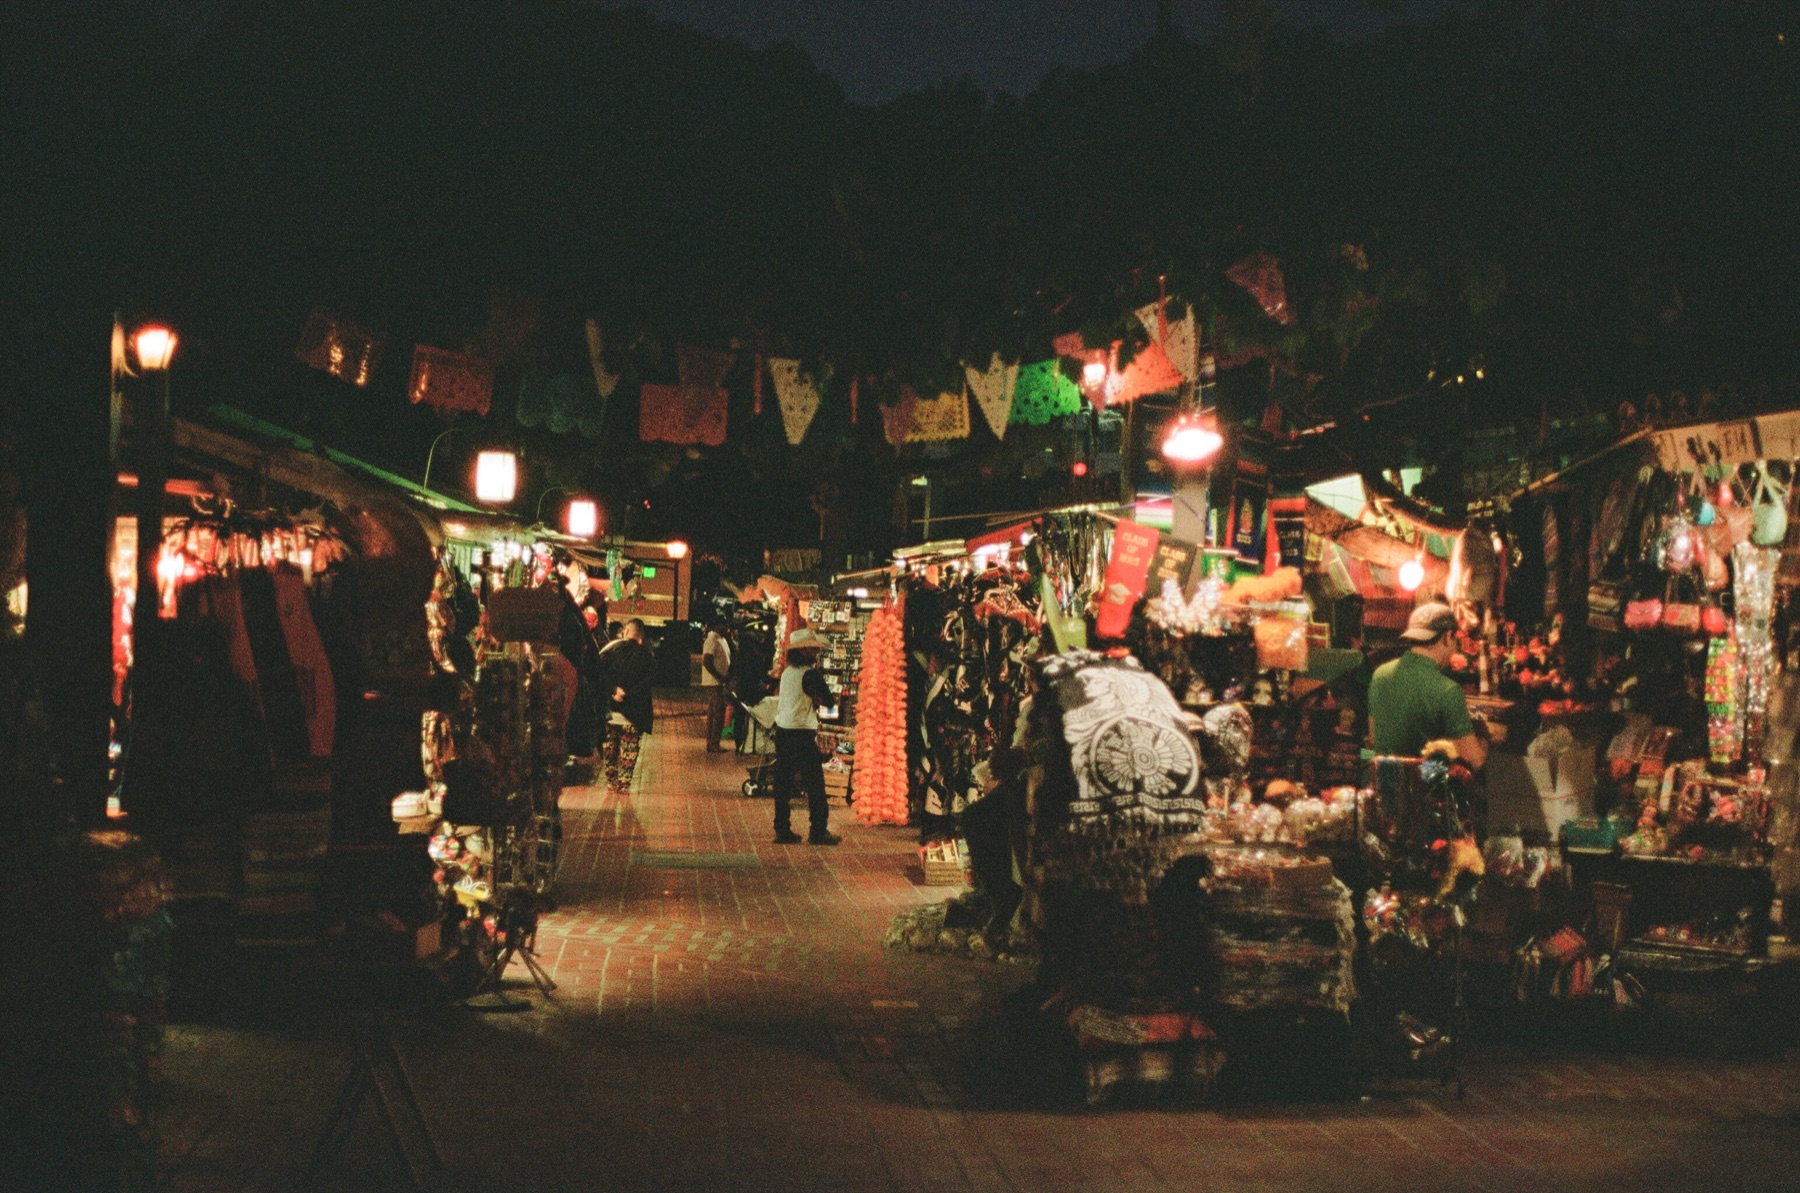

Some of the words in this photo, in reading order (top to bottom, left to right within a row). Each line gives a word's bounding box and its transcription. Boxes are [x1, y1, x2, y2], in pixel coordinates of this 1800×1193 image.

[1122, 531, 1148, 547] CLASS
[1126, 544, 1139, 554] OF
[1160, 546, 1186, 562] CLASS
[1164, 559, 1176, 568] OF
